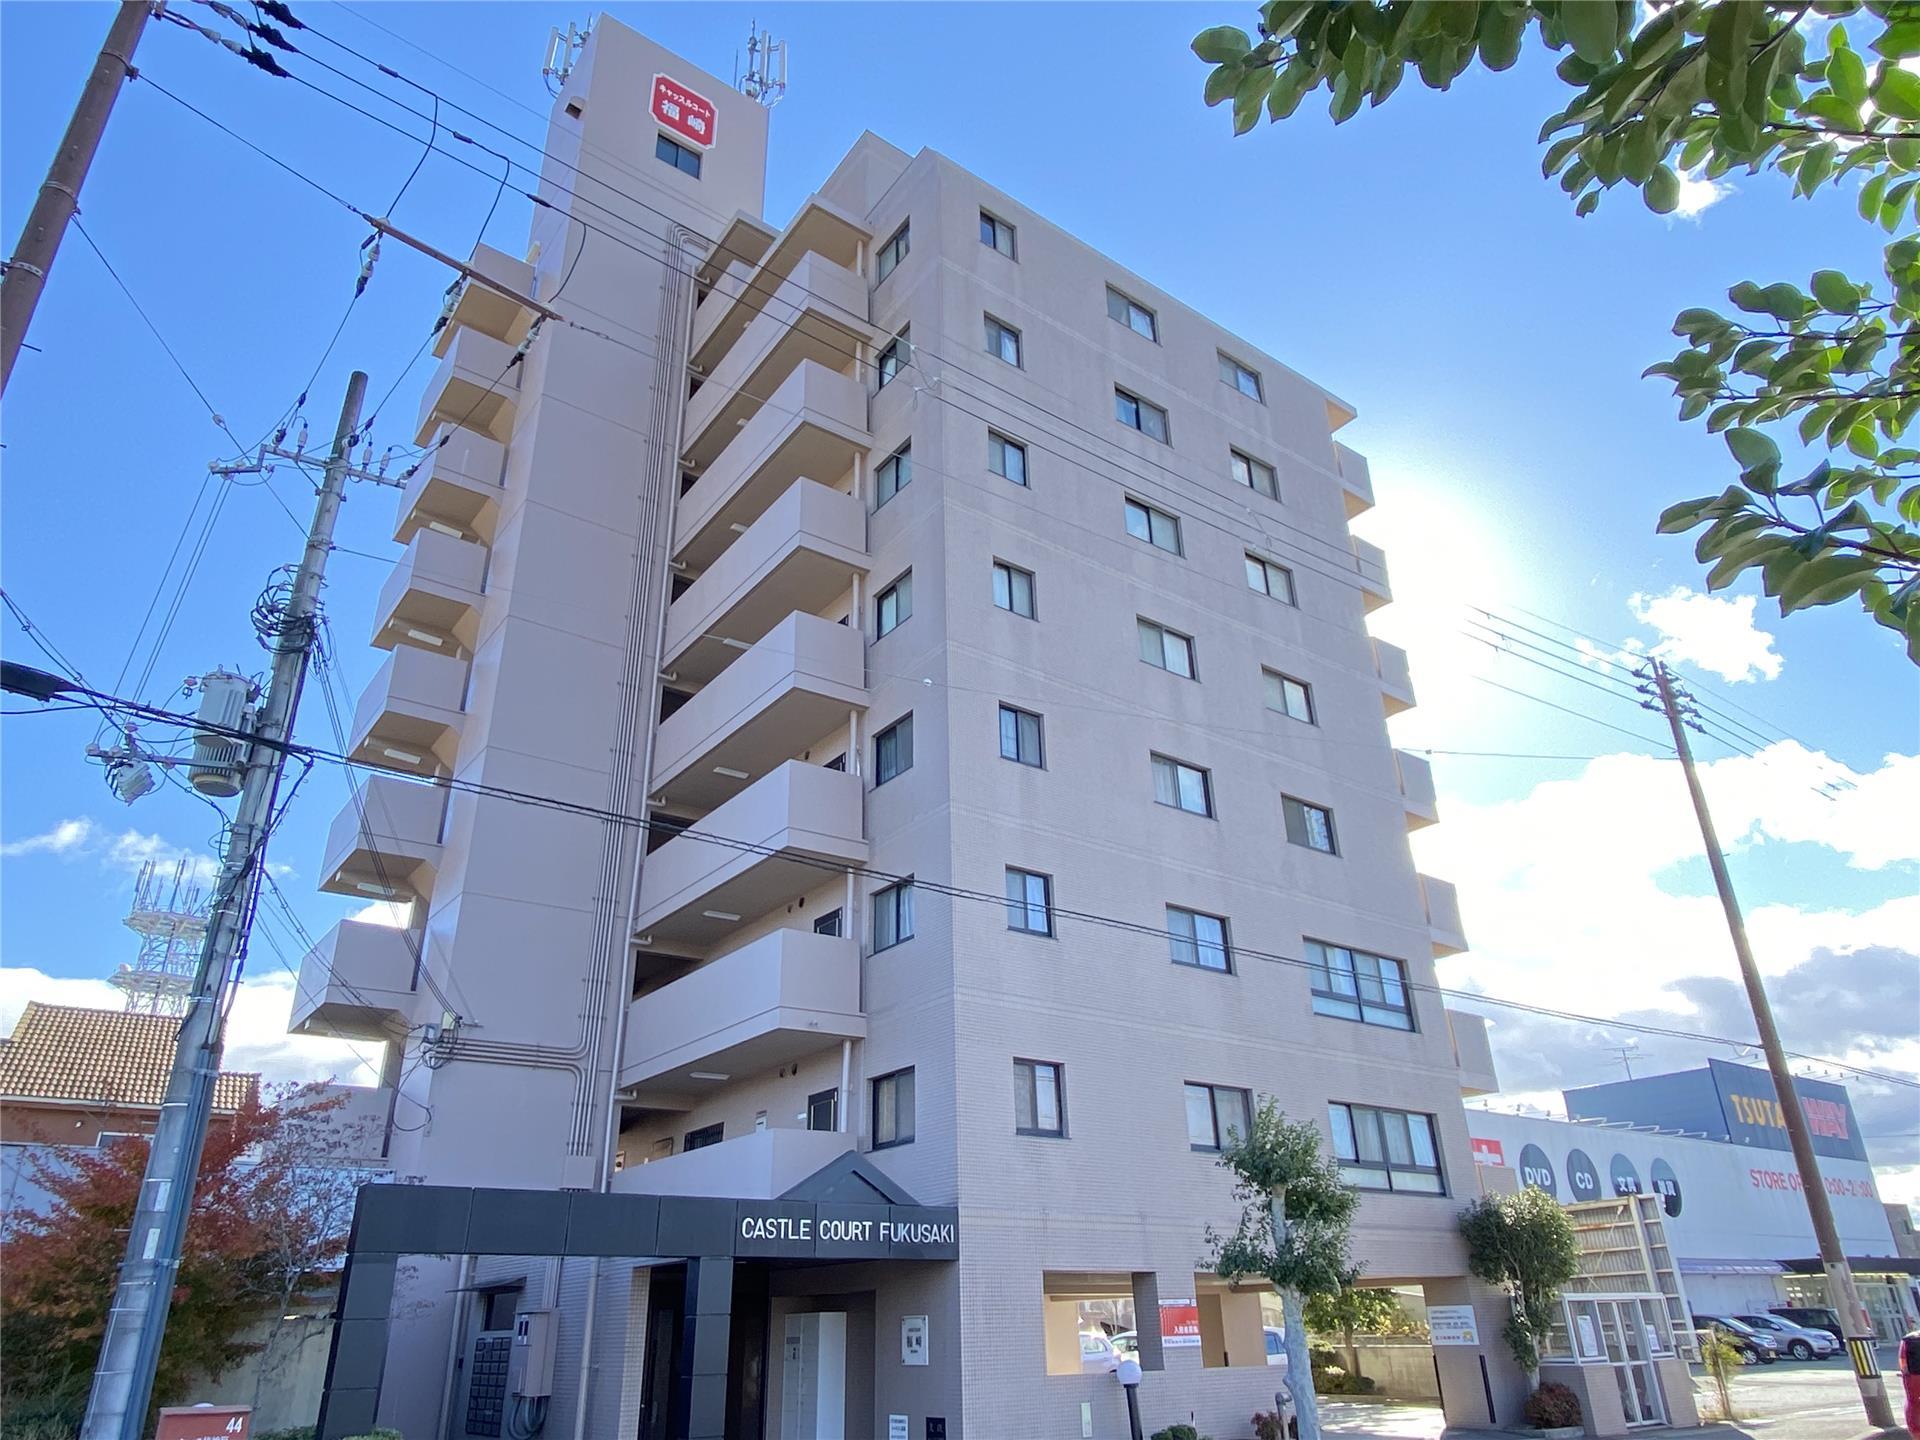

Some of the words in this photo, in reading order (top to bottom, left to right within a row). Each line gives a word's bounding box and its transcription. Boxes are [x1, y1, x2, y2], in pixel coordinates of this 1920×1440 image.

[659, 84, 710, 117] キャッスルコート
[1730, 1094, 1787, 1129] TSUTA
[1525, 1167, 1551, 1187] DVD
[1575, 1172, 1594, 1190] CD
[1617, 1176, 1637, 1194] 文具
[1750, 1169, 1789, 1191] STORE
[742, 1217, 812, 1240] CASTLE
[819, 1220, 873, 1241] COURT
[879, 1222, 955, 1244] FUKUSAKI
[226, 1417, 243, 1433] 44
